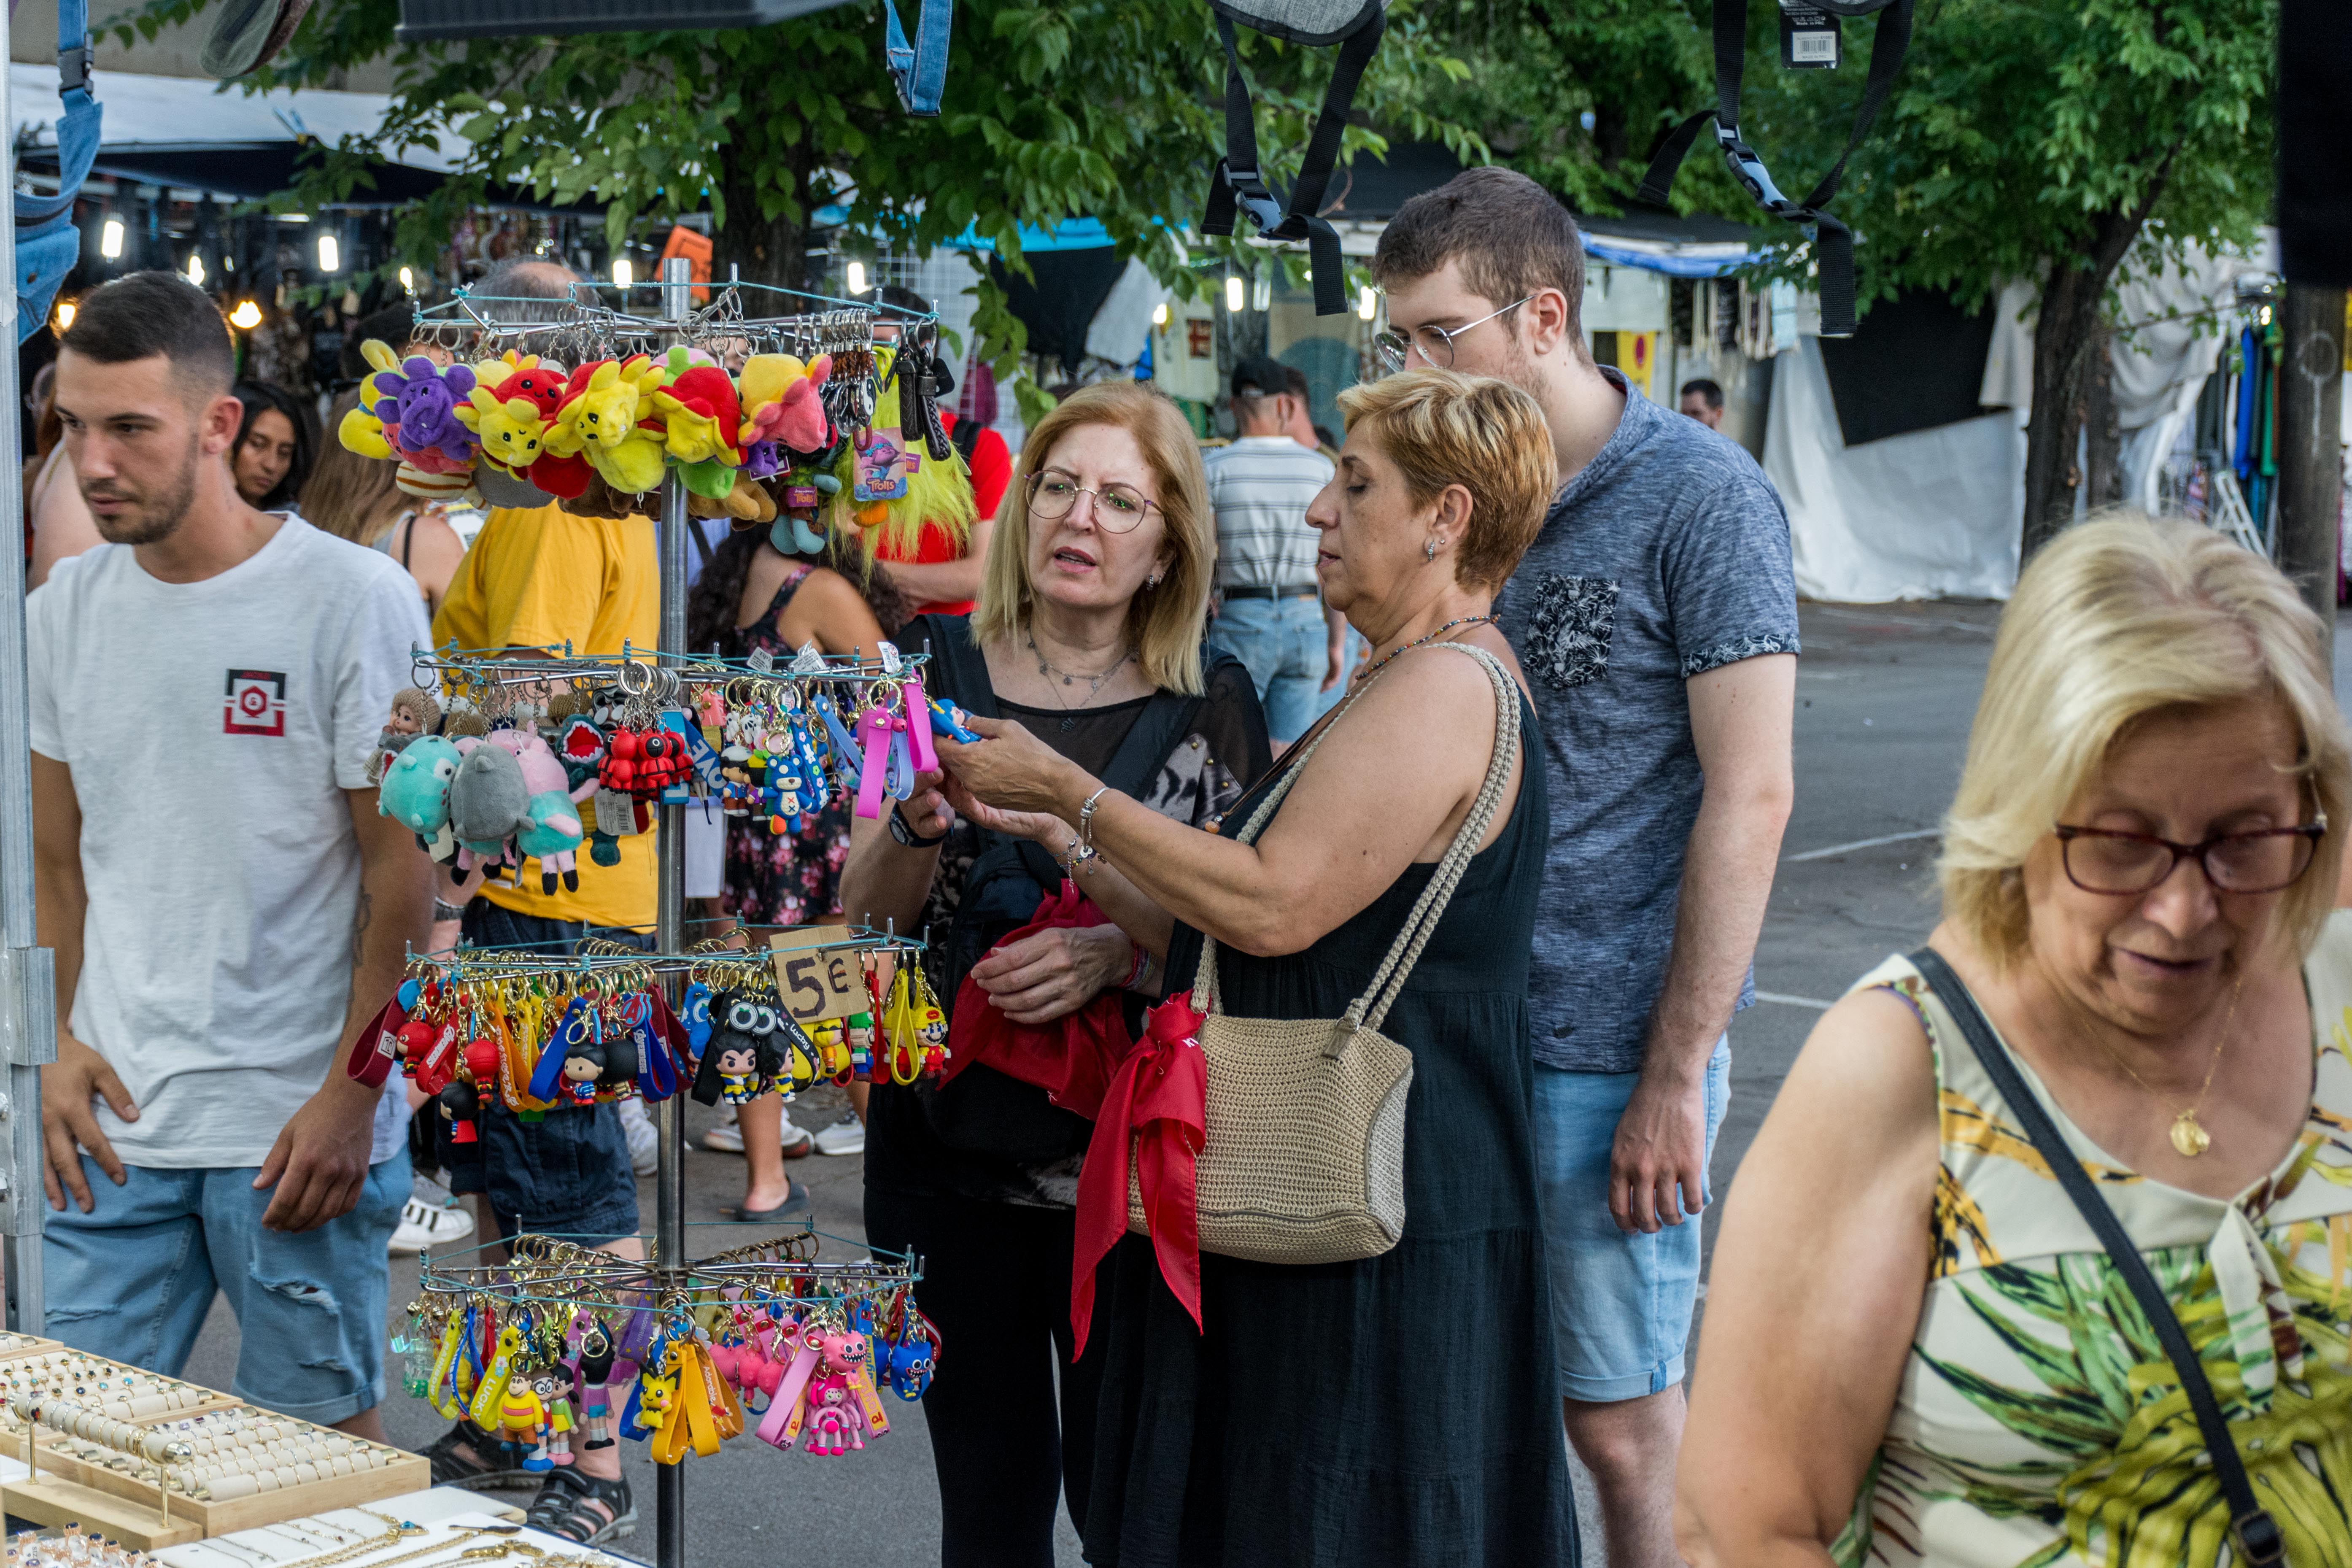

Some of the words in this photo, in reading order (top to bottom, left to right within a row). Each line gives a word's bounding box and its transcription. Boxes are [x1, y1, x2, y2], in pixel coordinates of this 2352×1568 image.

[793, 493, 813, 503] Trolls
[867, 480, 895, 492] Trolls
[692, 740, 726, 789] OVE
[790, 1024, 810, 1050] lucky
[430, 1341, 449, 1395] RAINBOW
[703, 1366, 717, 1399] Adorable
[474, 1378, 496, 1422] LUCKY
